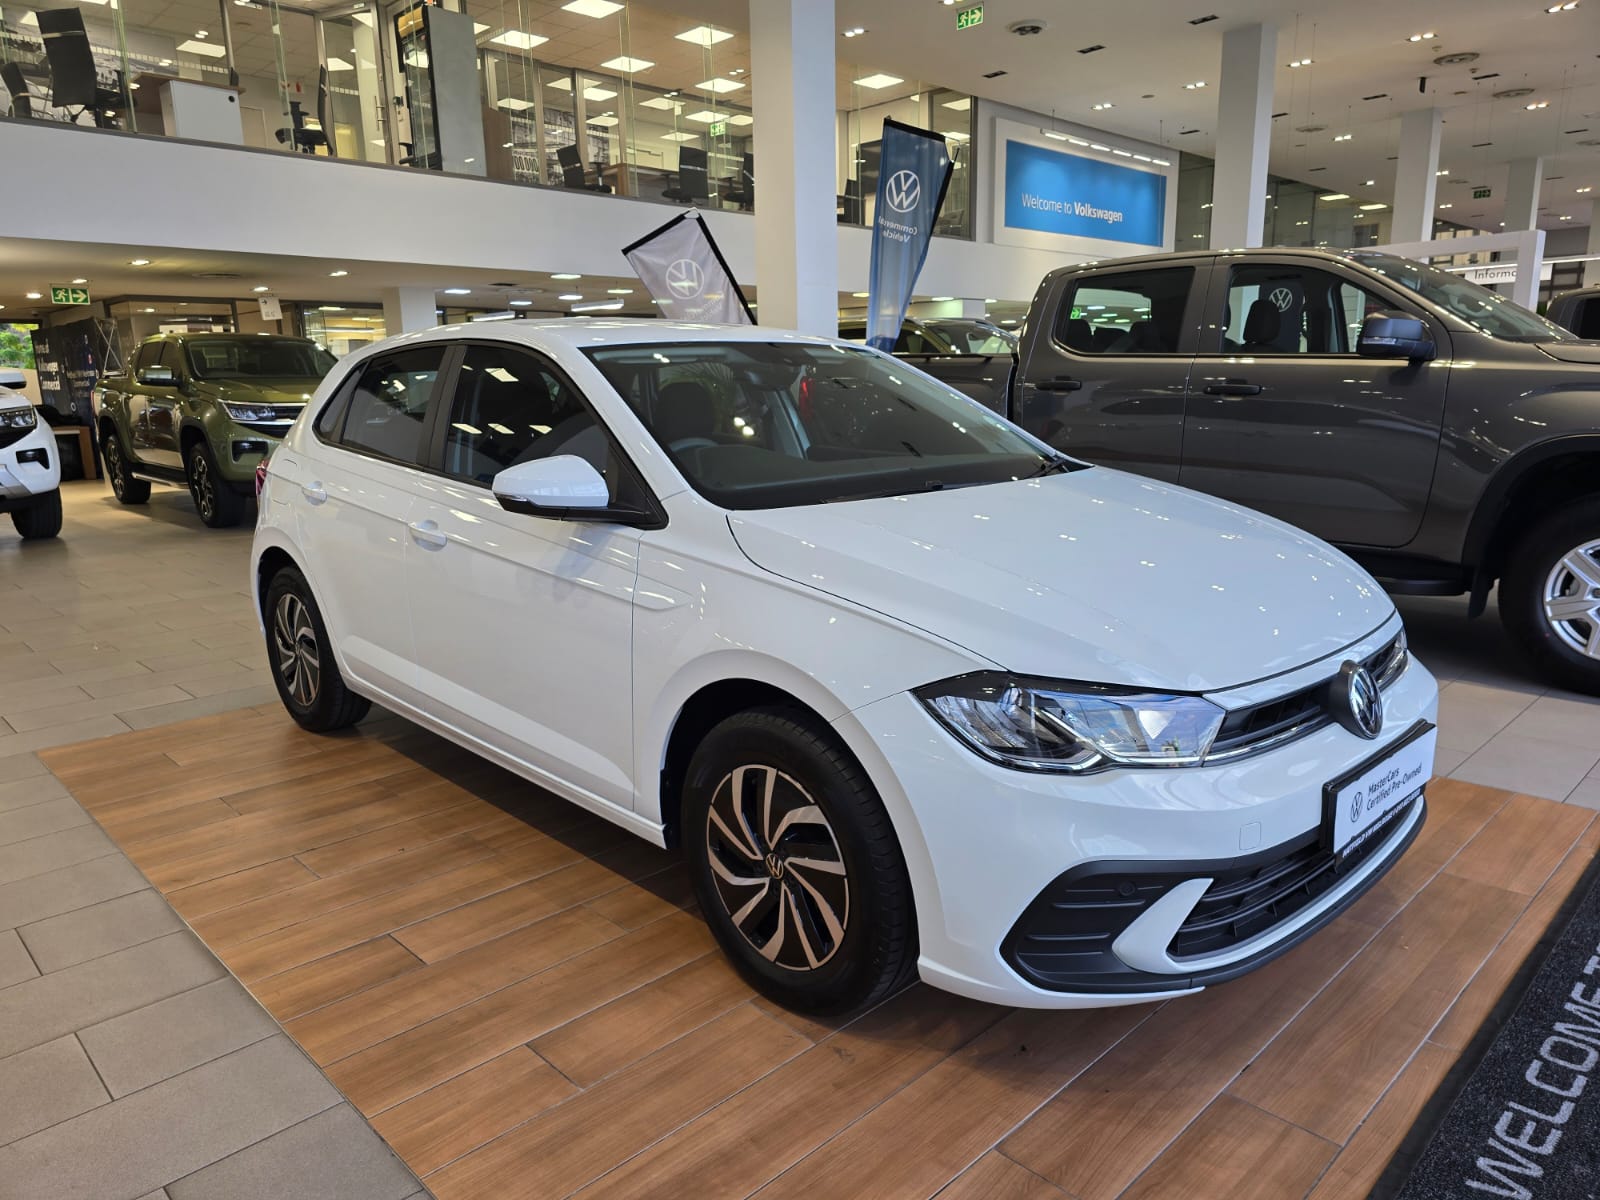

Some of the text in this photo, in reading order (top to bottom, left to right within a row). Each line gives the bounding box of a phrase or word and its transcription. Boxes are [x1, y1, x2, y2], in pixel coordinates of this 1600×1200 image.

[1022, 192, 1123, 223] Welcome to Volkswagen
[1366, 786, 1392, 811] Certified
[1391, 761, 1422, 793] Pre-Owned
[1368, 768, 1400, 797] MasterCars
